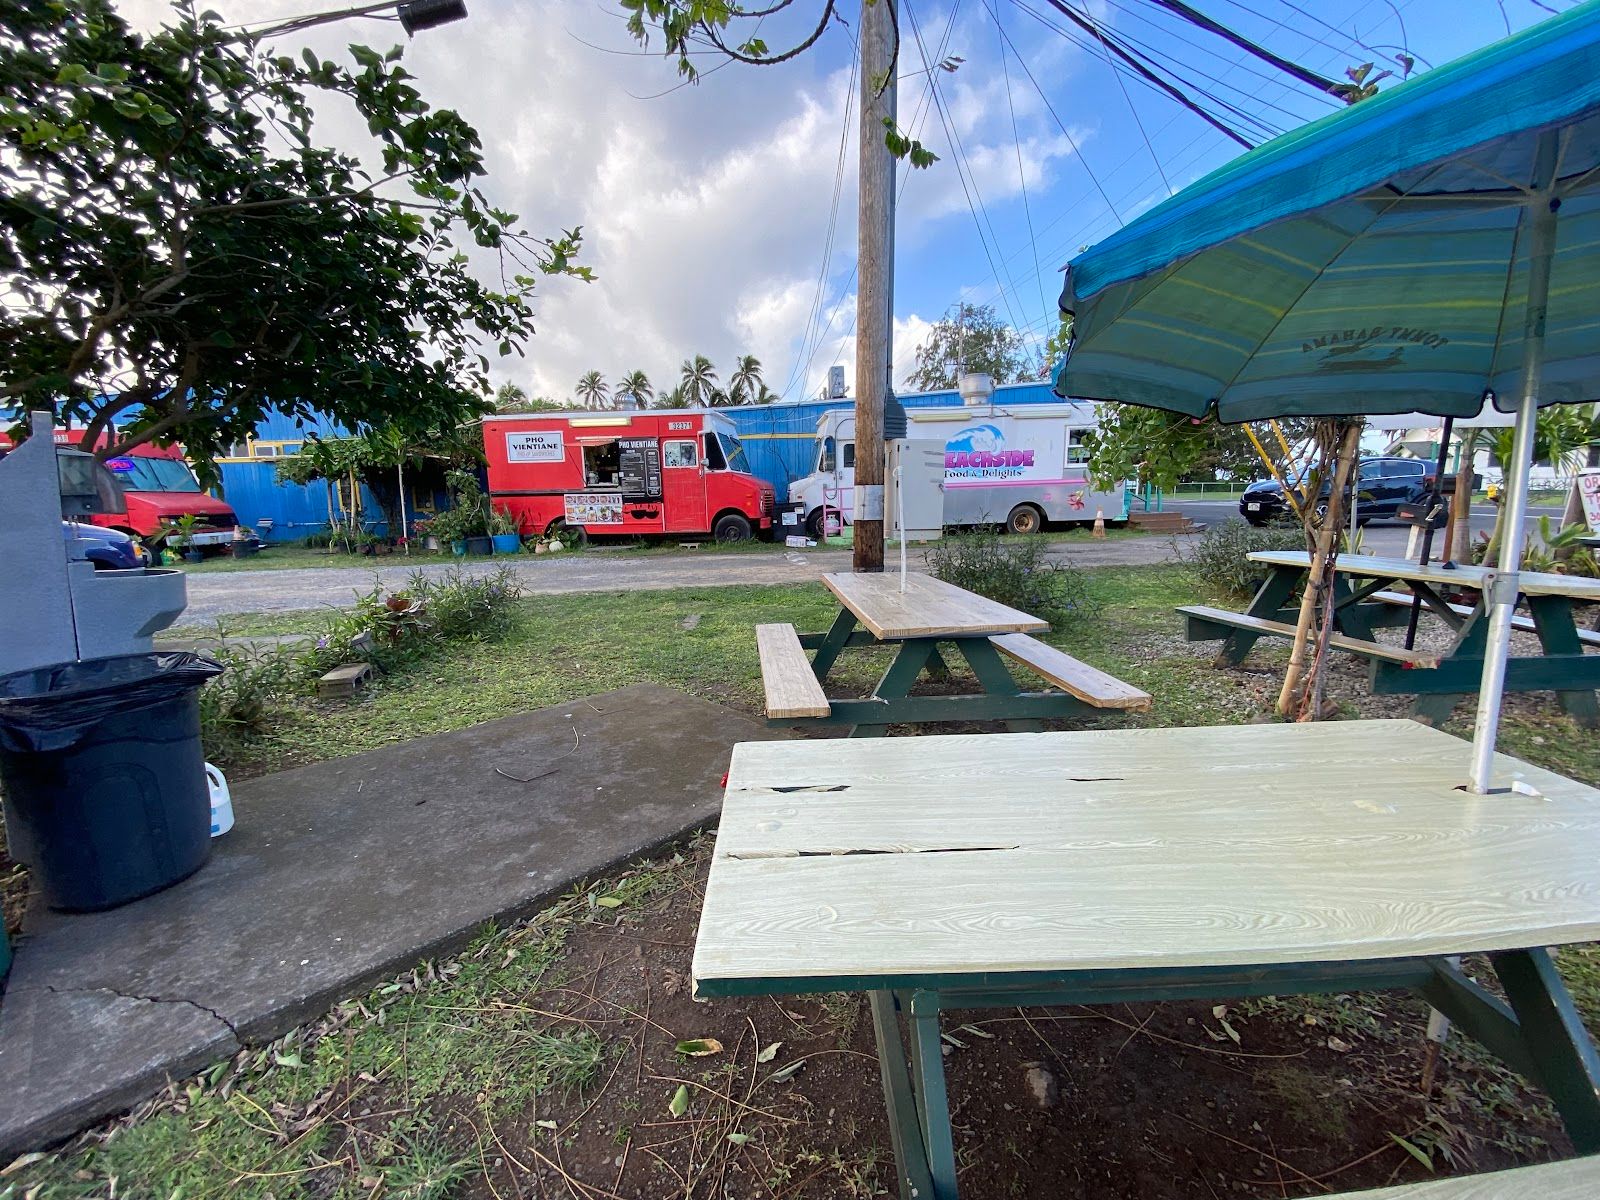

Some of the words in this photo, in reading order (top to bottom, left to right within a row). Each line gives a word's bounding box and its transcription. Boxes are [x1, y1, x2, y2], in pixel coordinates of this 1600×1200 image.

[512, 443, 559, 451] VIENTIANE
[618, 441, 630, 449] PHO
[631, 440, 658, 448] VIENTIANE
[944, 450, 1034, 468] EACHSIDE
[982, 469, 1022, 479] Delights
